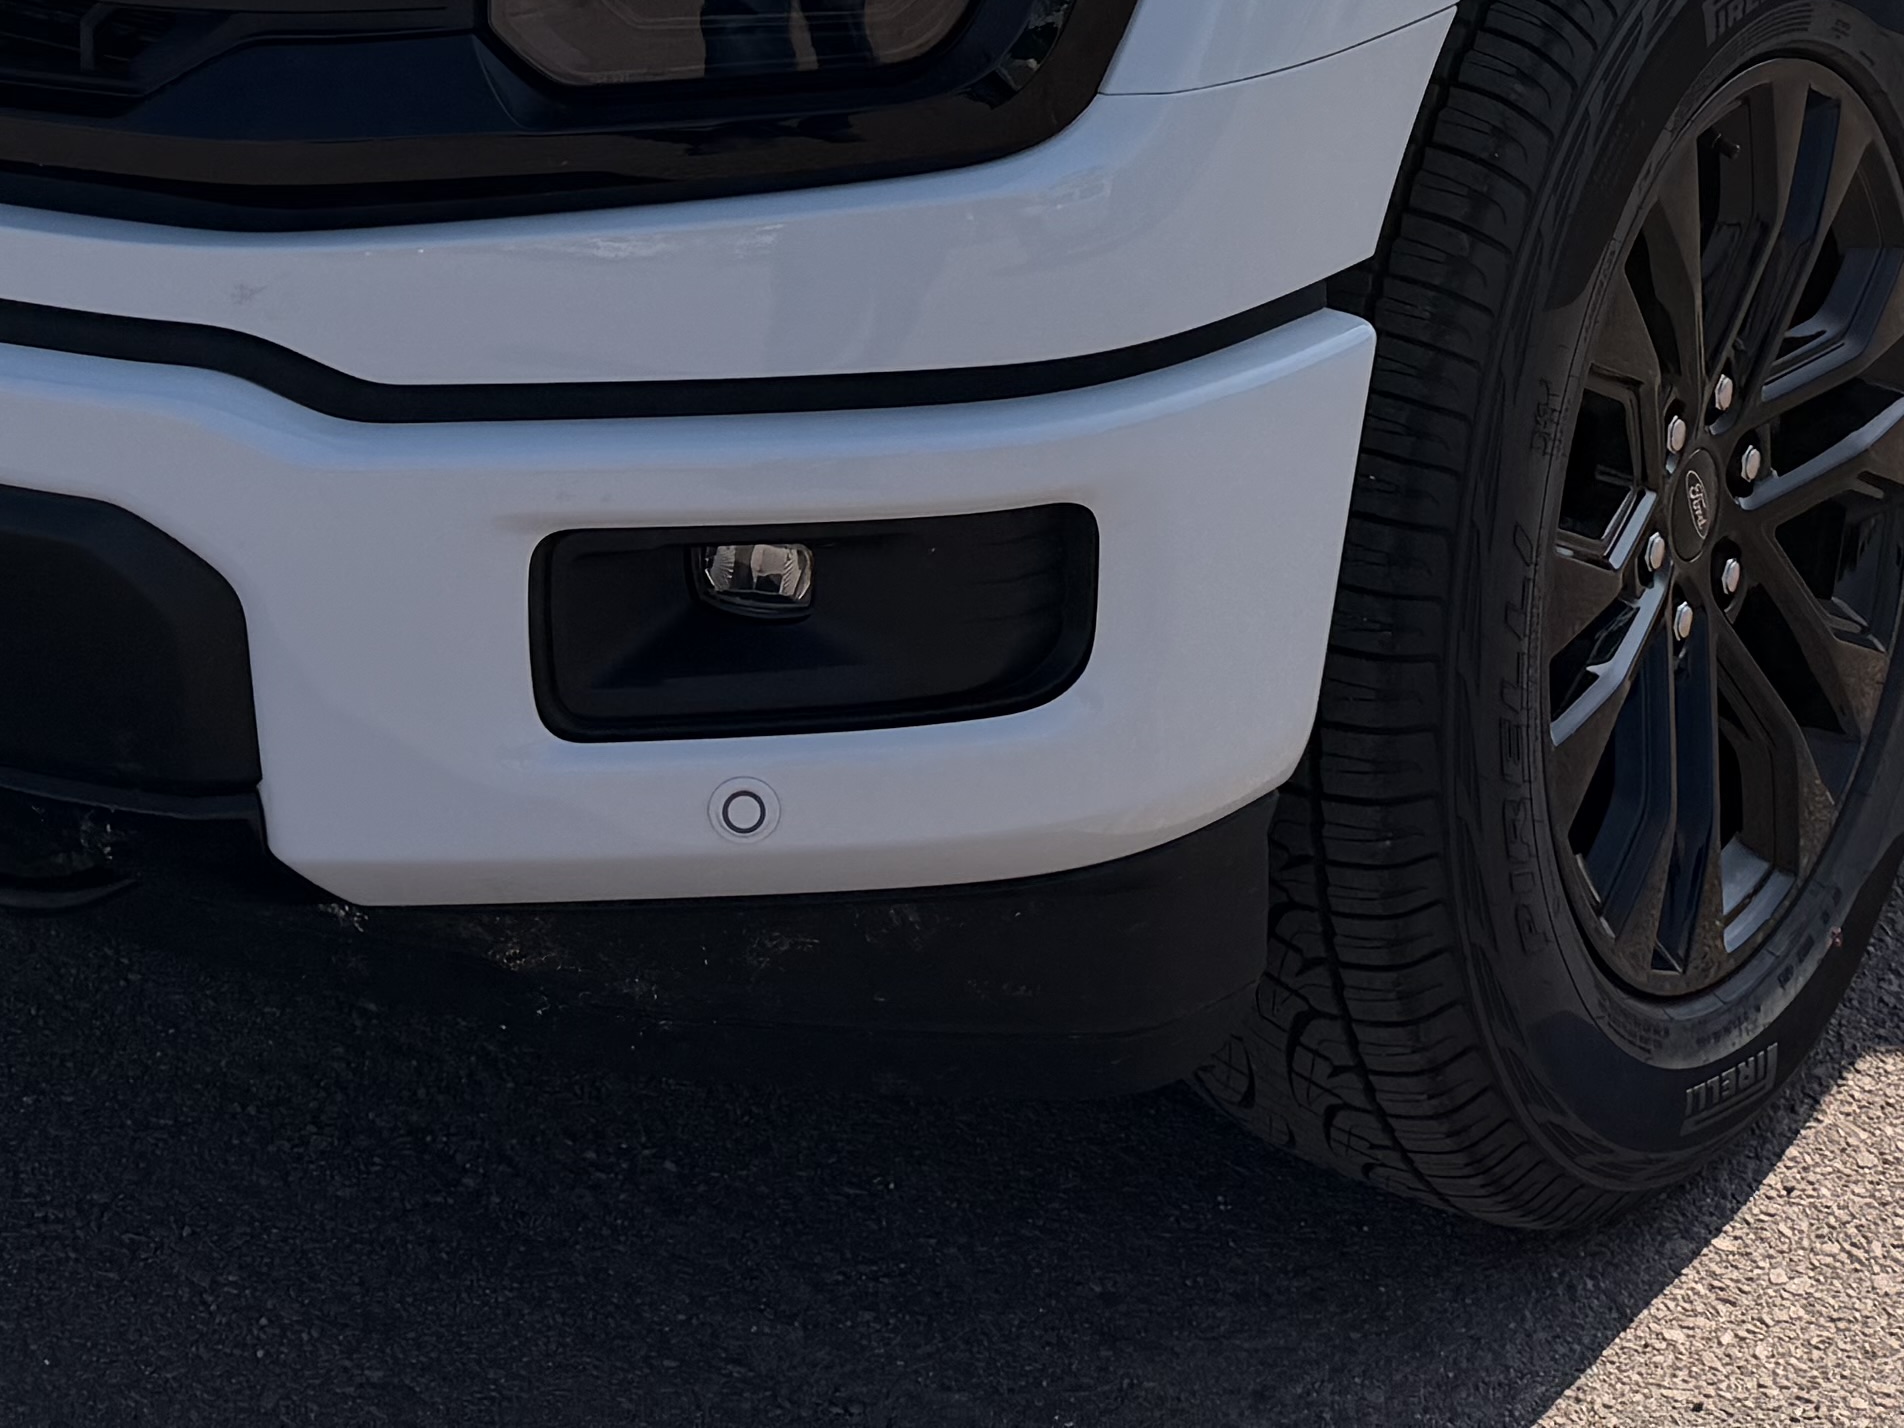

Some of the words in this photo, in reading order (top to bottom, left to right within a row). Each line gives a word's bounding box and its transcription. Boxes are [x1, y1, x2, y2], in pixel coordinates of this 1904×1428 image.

[1689, 483, 1708, 530] Ford
[1498, 521, 1549, 956] PIRELLI
[1680, 1041, 1779, 1137] PIRELLI
